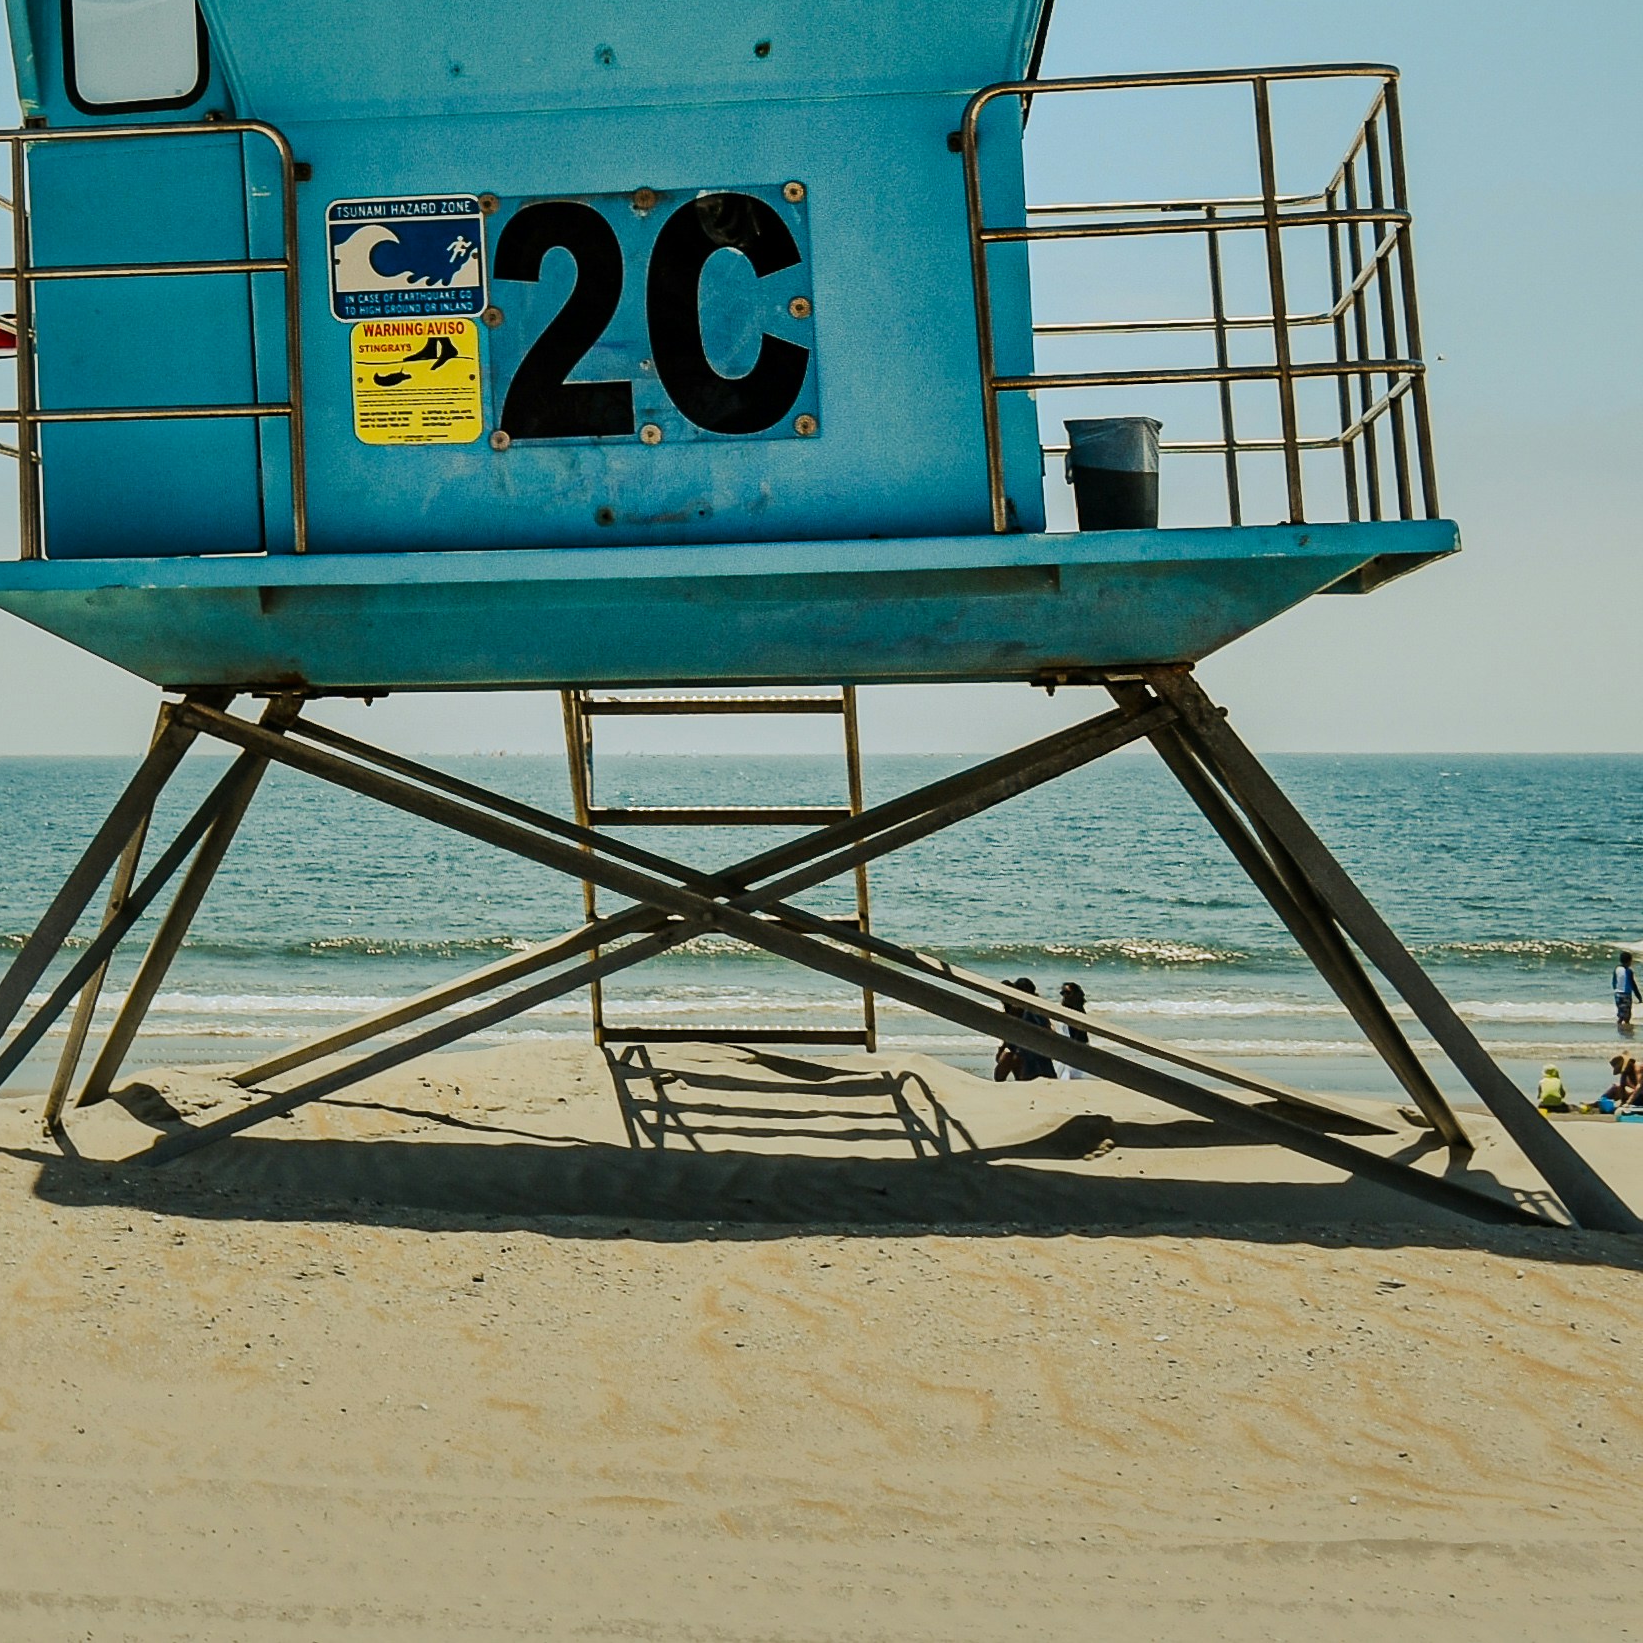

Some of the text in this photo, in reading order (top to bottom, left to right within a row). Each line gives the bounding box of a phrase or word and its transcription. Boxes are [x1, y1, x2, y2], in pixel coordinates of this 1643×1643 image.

[337, 200, 471, 218] TSUNAMI HAZARD ZONE
[358, 293, 380, 304] CASE
[383, 292, 394, 303] OF
[398, 290, 456, 303] EARTHQUAKE
[459, 289, 473, 300] GO
[345, 300, 473, 316] TO HIGH GROUND OR INLAND
[493, 192, 810, 440] 2C
[358, 343, 412, 354] STINGRAYS
